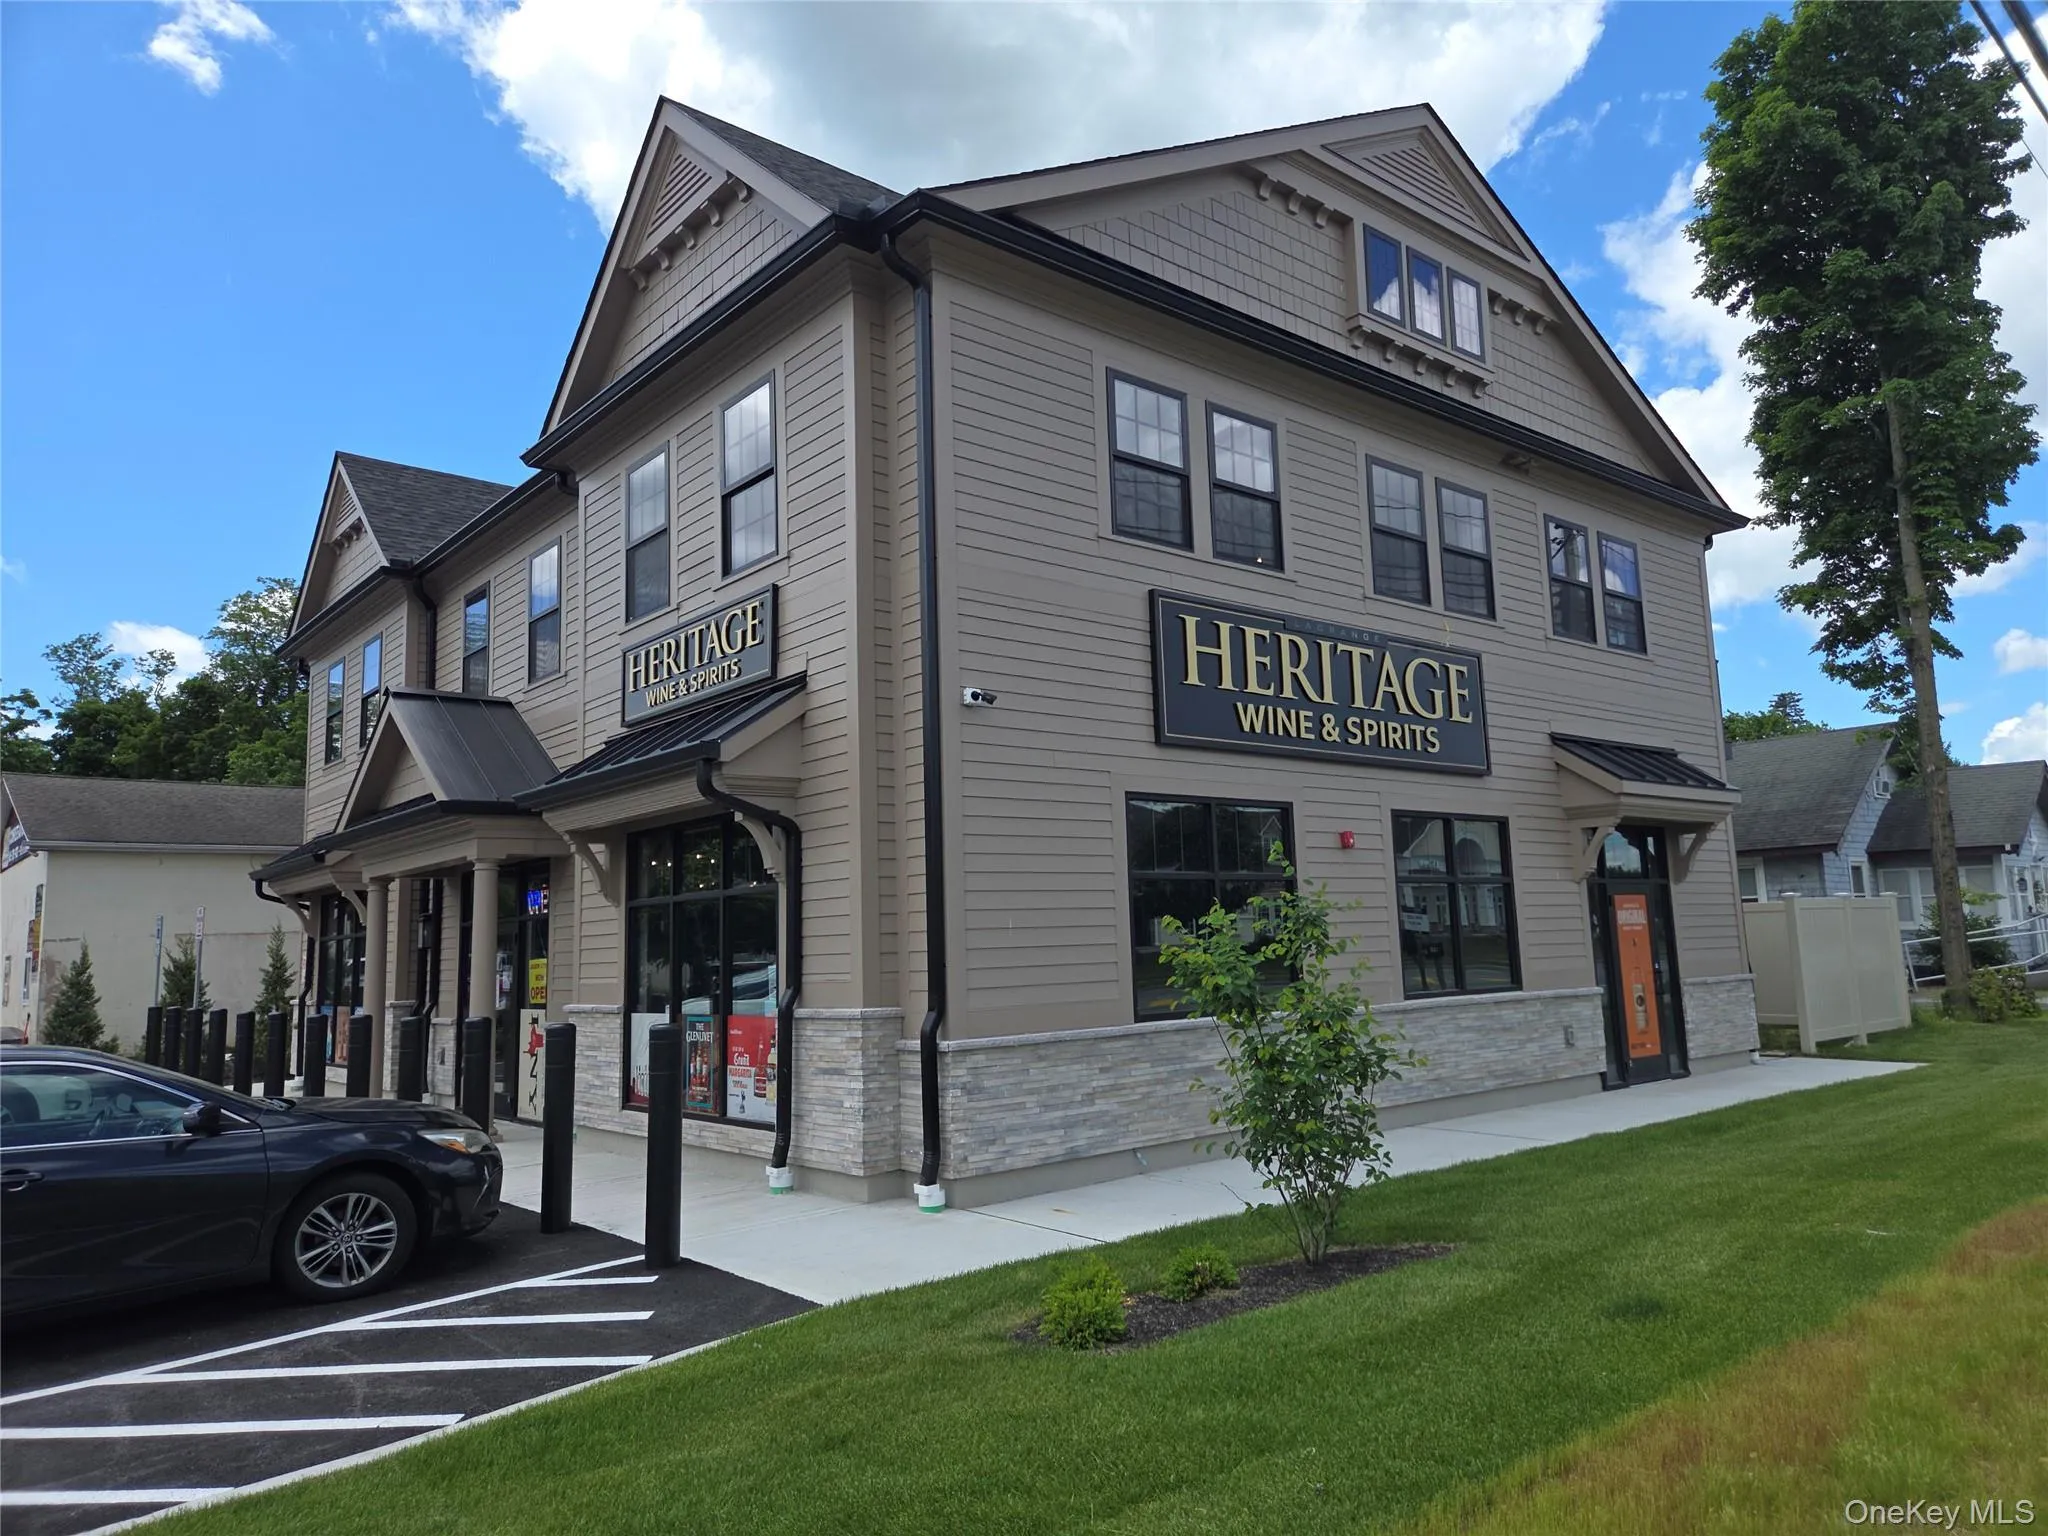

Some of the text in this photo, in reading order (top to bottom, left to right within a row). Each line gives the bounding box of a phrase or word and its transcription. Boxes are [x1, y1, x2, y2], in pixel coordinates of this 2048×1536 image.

[628, 601, 763, 692] HERITAGE
[1294, 621, 1380, 643] LAGRANGE
[646, 659, 740, 707] WINE & SPIRITS
[1179, 614, 1473, 724] HERITAGE
[1237, 702, 1440, 753] WINE & SPIRITS
[686, 1031, 713, 1043] GLENLIVET
[695, 1022, 705, 1031] THE
